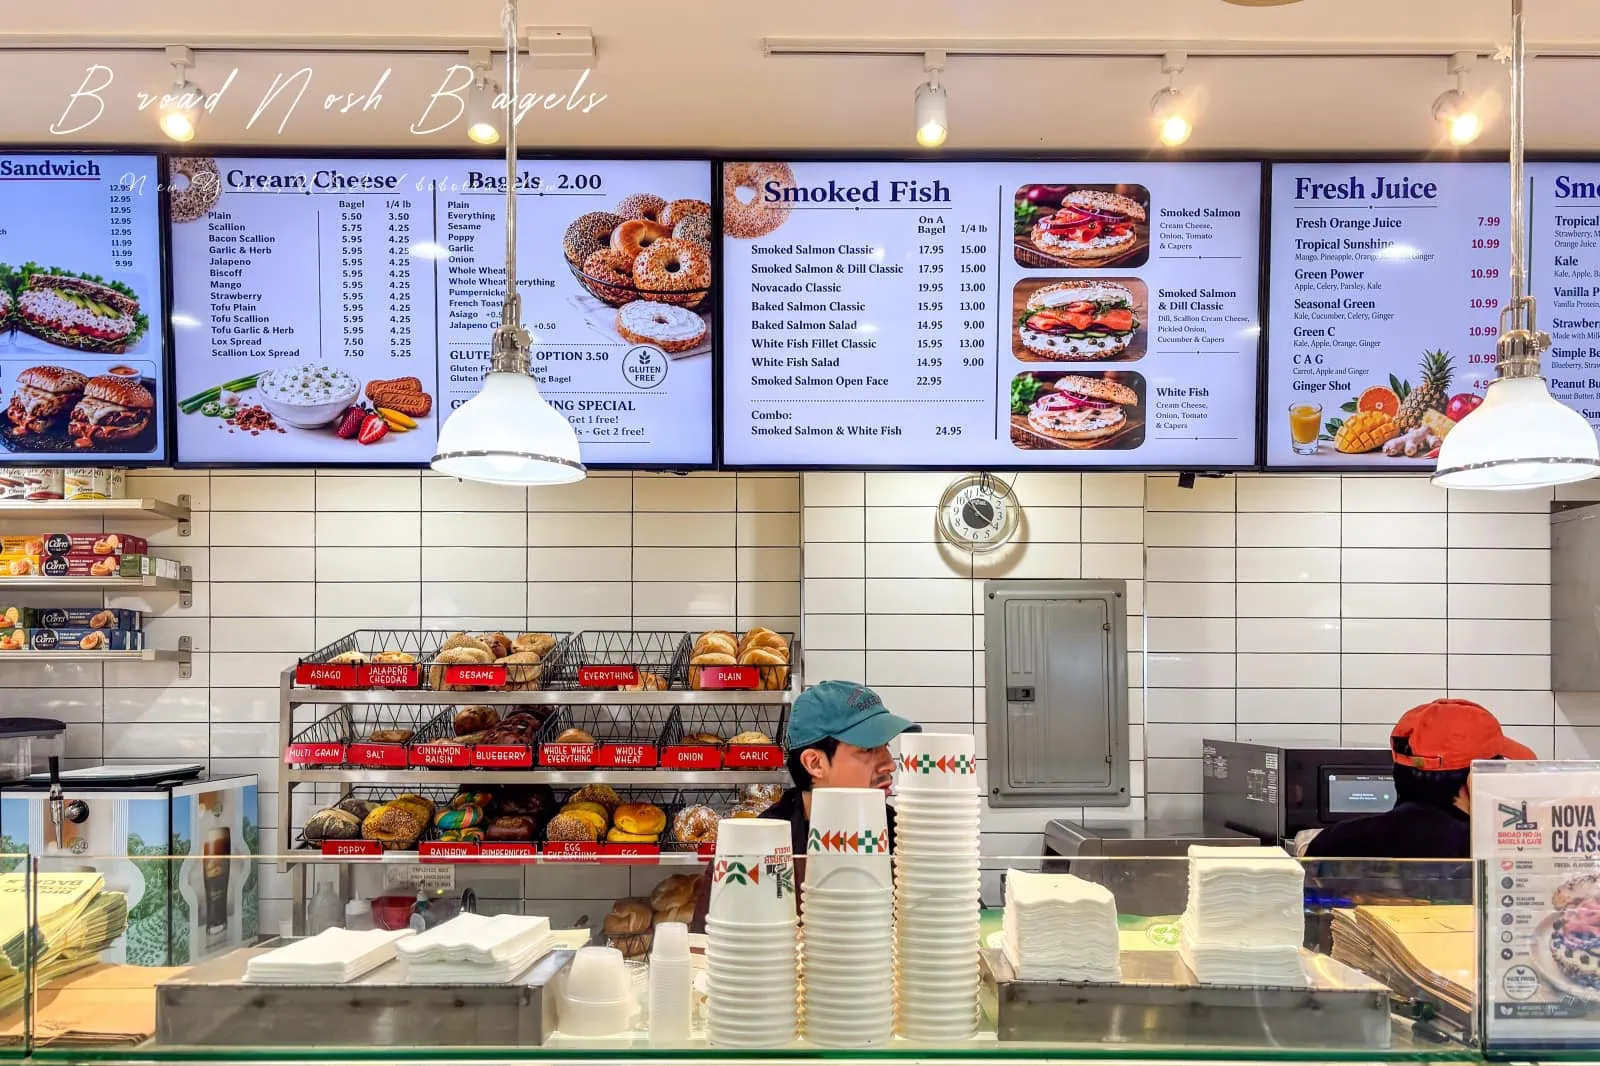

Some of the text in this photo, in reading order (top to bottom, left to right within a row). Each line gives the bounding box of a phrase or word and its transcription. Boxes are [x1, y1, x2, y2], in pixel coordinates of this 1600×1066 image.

[1, 160, 101, 176] Sandwich
[227, 169, 306, 188] Cream
[314, 170, 397, 188] Cheese
[467, 171, 541, 192] Bagels
[558, 174, 601, 189] 2.00
[764, 181, 952, 203] Smoked Fish
[1294, 176, 1437, 199] Fresh Juice
[110, 195, 131, 203] 12.95
[339, 200, 365, 210] Bagel
[386, 200, 411, 209] 1/4 lb
[448, 201, 469, 209] Plain
[110, 206, 131, 214] 12.95
[1160, 208, 1241, 217] Smoked Salmon
[208, 211, 231, 221] Plain
[342, 212, 362, 220] 5.50
[448, 211, 496, 221] Everything
[919, 216, 944, 224] On A
[448, 222, 481, 230] Sesame
[1296, 217, 1402, 230] Fresh Orange Juice
[1478, 217, 1500, 226] 7.99
[1555, 215, 1599, 229] Tropical
[208, 222, 246, 231] Scallion
[918, 225, 945, 236] Bagel
[961, 224, 988, 234] 1/4 lb
[209, 234, 275, 243] Bacon Scallion
[448, 233, 475, 243] Poppy
[1159, 233, 1213, 241] Onion, Tomato
[112, 239, 132, 247] 11.99
[1167, 242, 1193, 250] Capers
[1472, 238, 1500, 249] 10.99
[209, 246, 272, 254] Garlic & Herb
[448, 244, 474, 252] Garlic
[751, 244, 874, 255] Smoked Salmon Classic
[209, 257, 251, 267] Jalapeno
[1554, 256, 1578, 266] Kale
[209, 269, 242, 277] Biscoff
[751, 263, 903, 274] Smoked Salmon & Dill Classic
[1294, 269, 1364, 279] Green Power
[210, 280, 242, 290] Mango
[751, 282, 841, 293] Novacado Classic
[919, 283, 943, 292] 19.95
[1554, 286, 1589, 297] Vanilla
[210, 292, 262, 302] Strawberry
[210, 303, 256, 311] Tofu Plain
[1158, 301, 1224, 310] & Dill Classic
[1294, 298, 1375, 309] Seasonal Green
[449, 310, 478, 319] Asiago
[752, 320, 857, 330] Baked Salmon Salad
[963, 320, 985, 329] 9.00
[211, 325, 294, 334] Tofu Garlic & Herb
[1293, 326, 1335, 337] Green C
[211, 337, 262, 347] Lox Spread
[344, 338, 364, 346] 7.50
[390, 338, 411, 346] 5.25
[751, 338, 877, 349] White Fish Fillet Classic
[344, 349, 364, 357] 7.50
[536, 351, 609, 361] OPTION 3.50
[1552, 347, 1586, 360] Simple
[1293, 354, 1323, 364] C A G
[628, 366, 661, 375] GLUTEN
[635, 374, 655, 382] FREE
[1293, 380, 1351, 393] Ginger Shot
[1551, 379, 1585, 389] Peanut
[1156, 387, 1209, 397] White Fish
[578, 400, 636, 411] SPECIAL
[751, 410, 792, 420] Combo:
[593, 427, 644, 436] Get 2 free!
[751, 426, 902, 435] Smoked Salmon & White Fish
[310, 670, 341, 680] ASIAGO
[369, 675, 408, 684] CHEDDAR
[459, 670, 495, 680] SESAME
[584, 672, 635, 681] EVERYTHING
[718, 672, 742, 681] PLAIN
[289, 748, 340, 758] MULTI GRAIN
[417, 746, 461, 755] CINNAMON
[543, 745, 594, 754] WHOLE WHEAT
[615, 747, 644, 755] WHOLE
[366, 750, 385, 759] SALT
[476, 751, 526, 761] BLUEBERRY
[547, 754, 592, 763] EVERYTHING
[678, 752, 704, 761] ONION
[739, 751, 769, 760] GARLIC
[425, 755, 453, 764] RAISIN
[614, 755, 642, 764] WHEAT
[1551, 805, 1596, 828] NOVA
[1551, 830, 1600, 853] CLAS
[338, 845, 366, 854] POPPY
[564, 843, 580, 852] EGG
